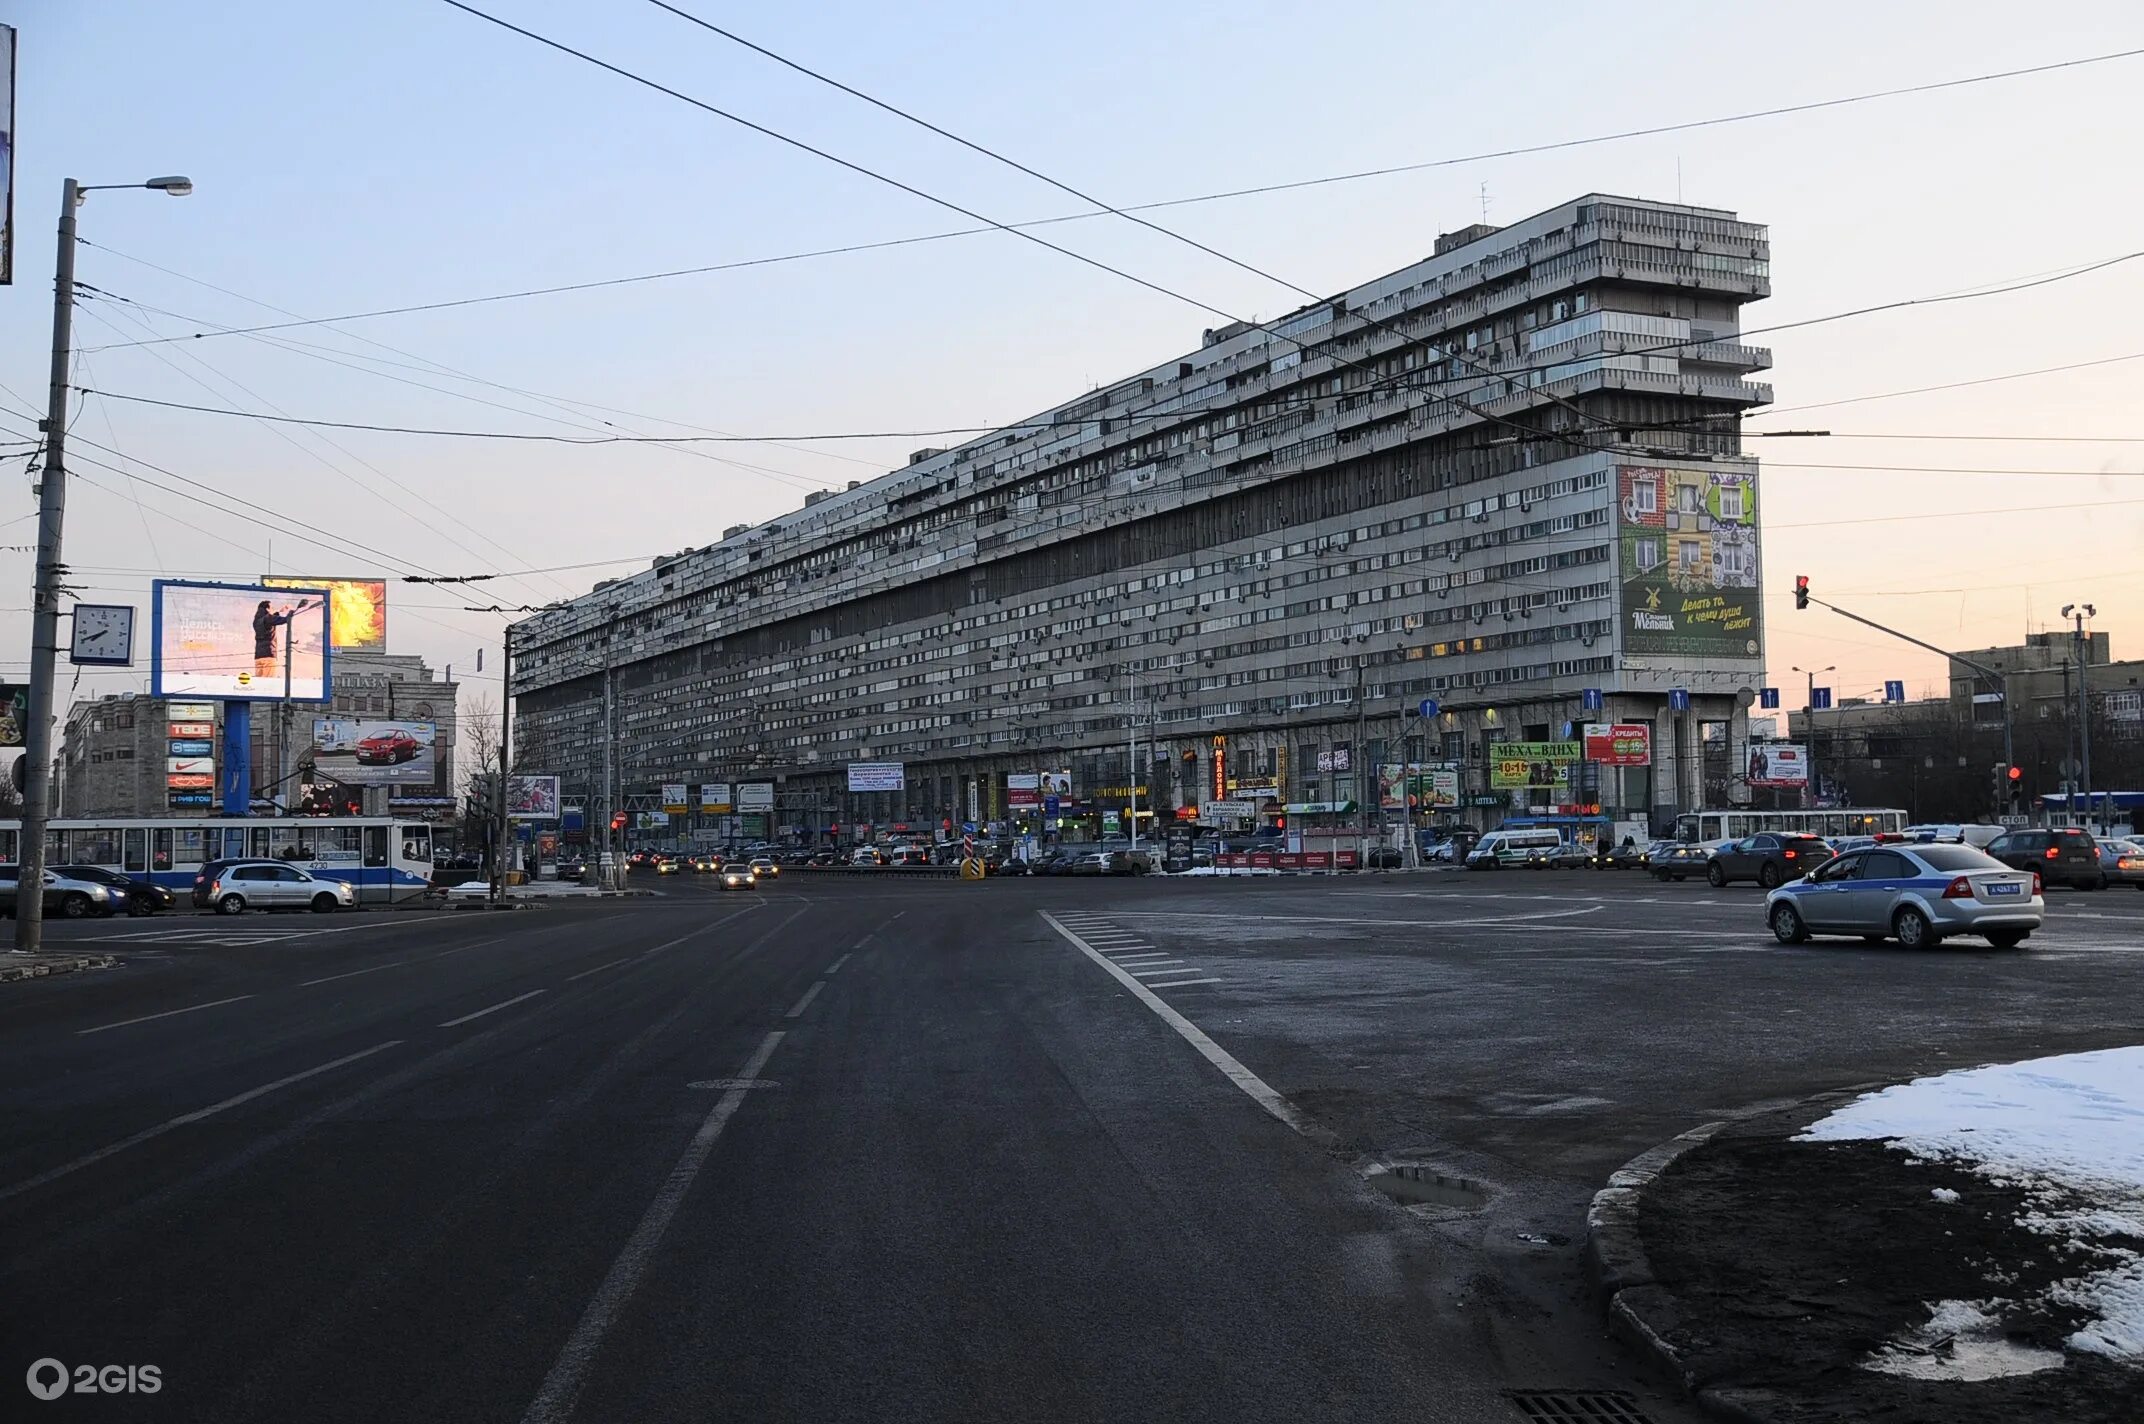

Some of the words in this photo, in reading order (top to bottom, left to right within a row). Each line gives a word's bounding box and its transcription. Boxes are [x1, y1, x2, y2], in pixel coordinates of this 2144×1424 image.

[1680, 598, 1711, 612] Делать
[1695, 610, 1718, 622] чему
[1718, 605, 1742, 621] душа
[1632, 612, 1675, 630] Мельник
[1723, 617, 1752, 631] лежит
[341, 677, 387, 688] ПЛАЗА
[1497, 744, 1532, 757] МЕХА
[1541, 743, 1575, 757] ВДНХ
[1474, 797, 1498, 805] АПТЕКА
[2001, 816, 2026, 824] СТОП
[309, 862, 328, 870] 4230
